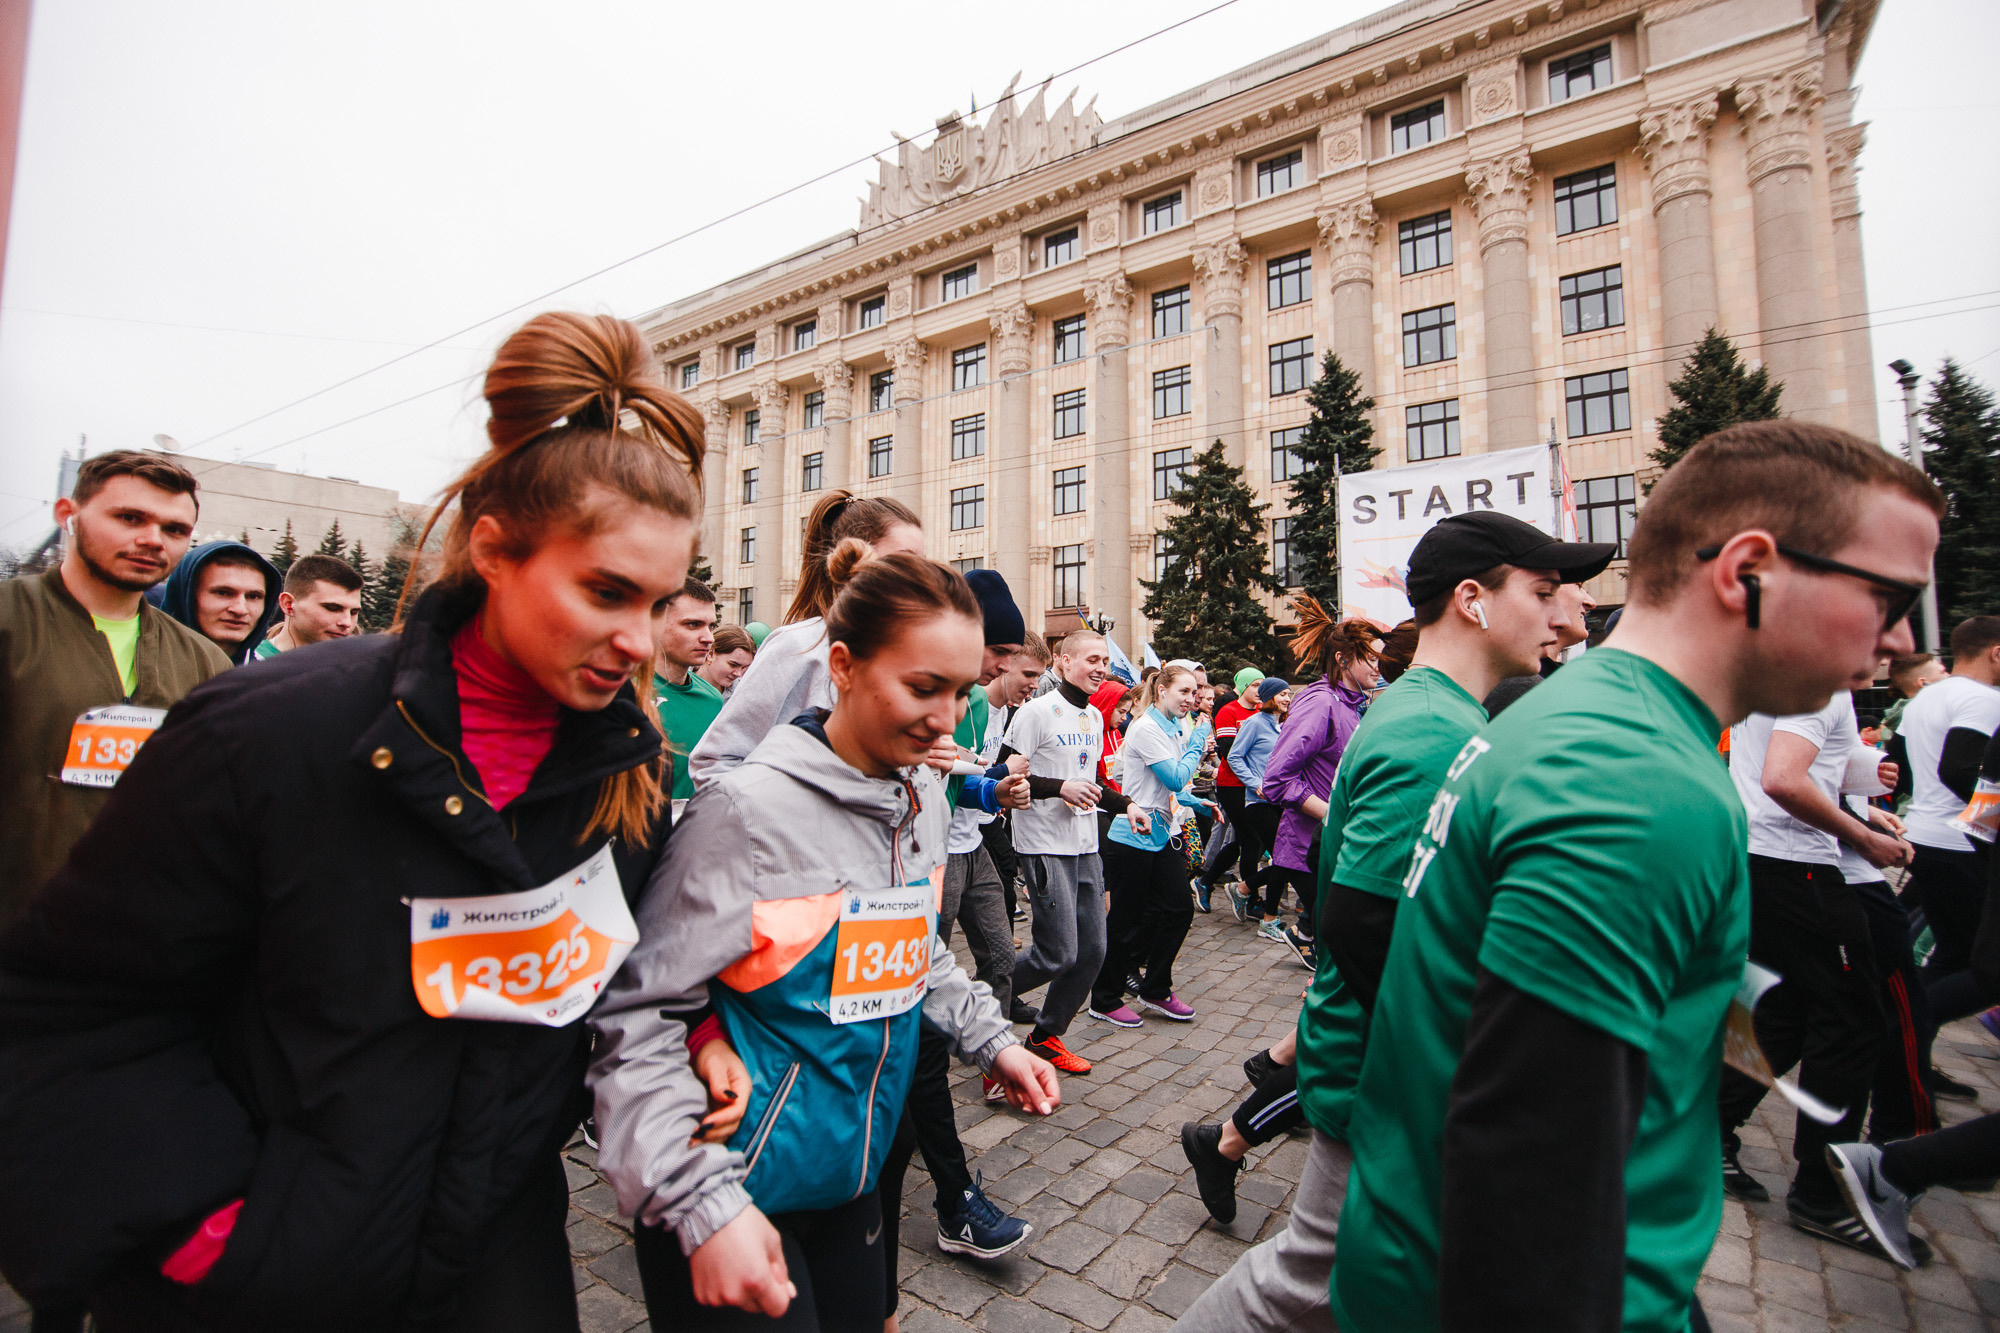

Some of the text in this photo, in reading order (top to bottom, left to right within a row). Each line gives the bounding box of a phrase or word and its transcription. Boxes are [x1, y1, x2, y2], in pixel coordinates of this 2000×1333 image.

[1353, 471, 1535, 524] START
[99, 712, 153, 723] Жилстрой-1
[76, 737, 145, 765] 133
[425, 921, 591, 1013] 13325
[842, 935, 928, 983] 13433
[838, 1001, 858, 1018] 4,2
